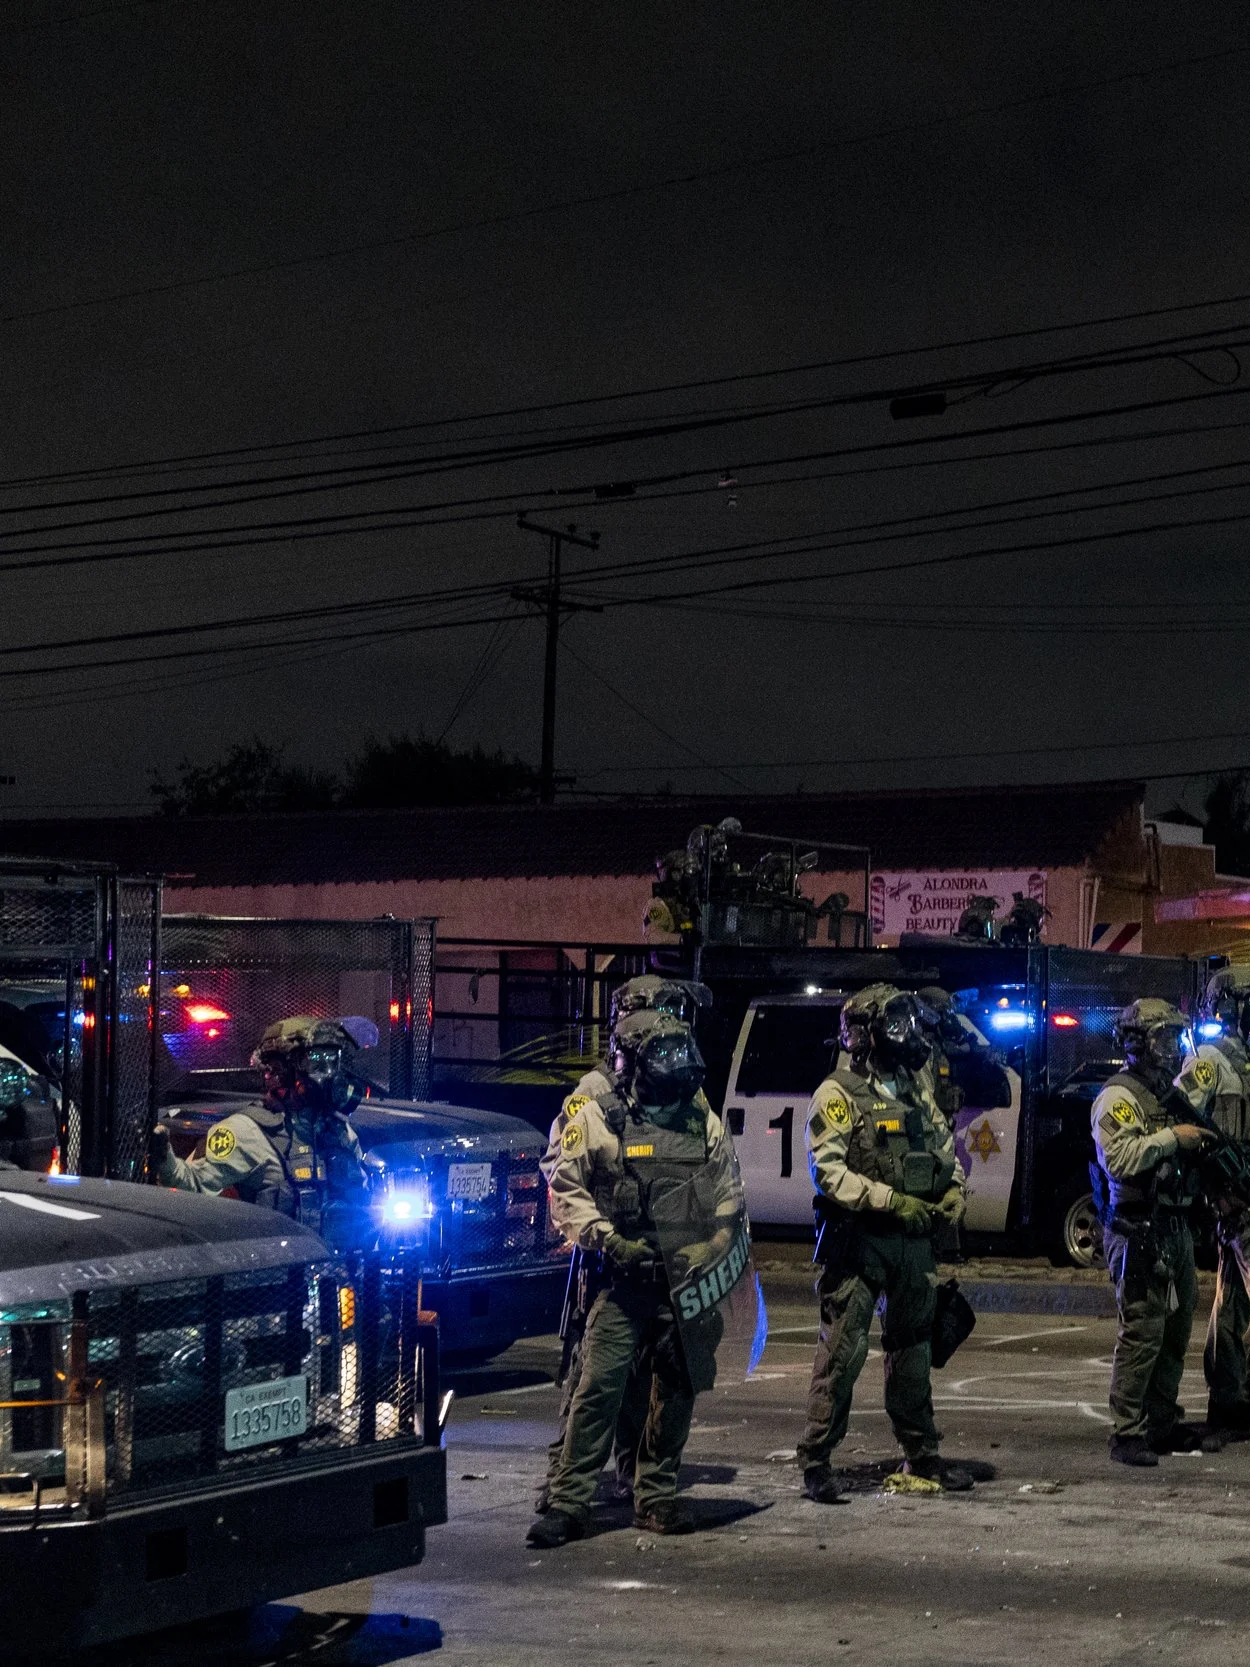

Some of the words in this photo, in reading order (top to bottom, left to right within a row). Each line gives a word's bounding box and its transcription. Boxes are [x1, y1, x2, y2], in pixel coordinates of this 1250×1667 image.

[923, 877, 988, 891] ALONDRA
[907, 894, 966, 915] BARBER
[906, 918, 958, 935] BEAUTY
[769, 1107, 793, 1177] 1
[679, 1226, 749, 1321] SHERI
[231, 1397, 301, 1440] 1335758
